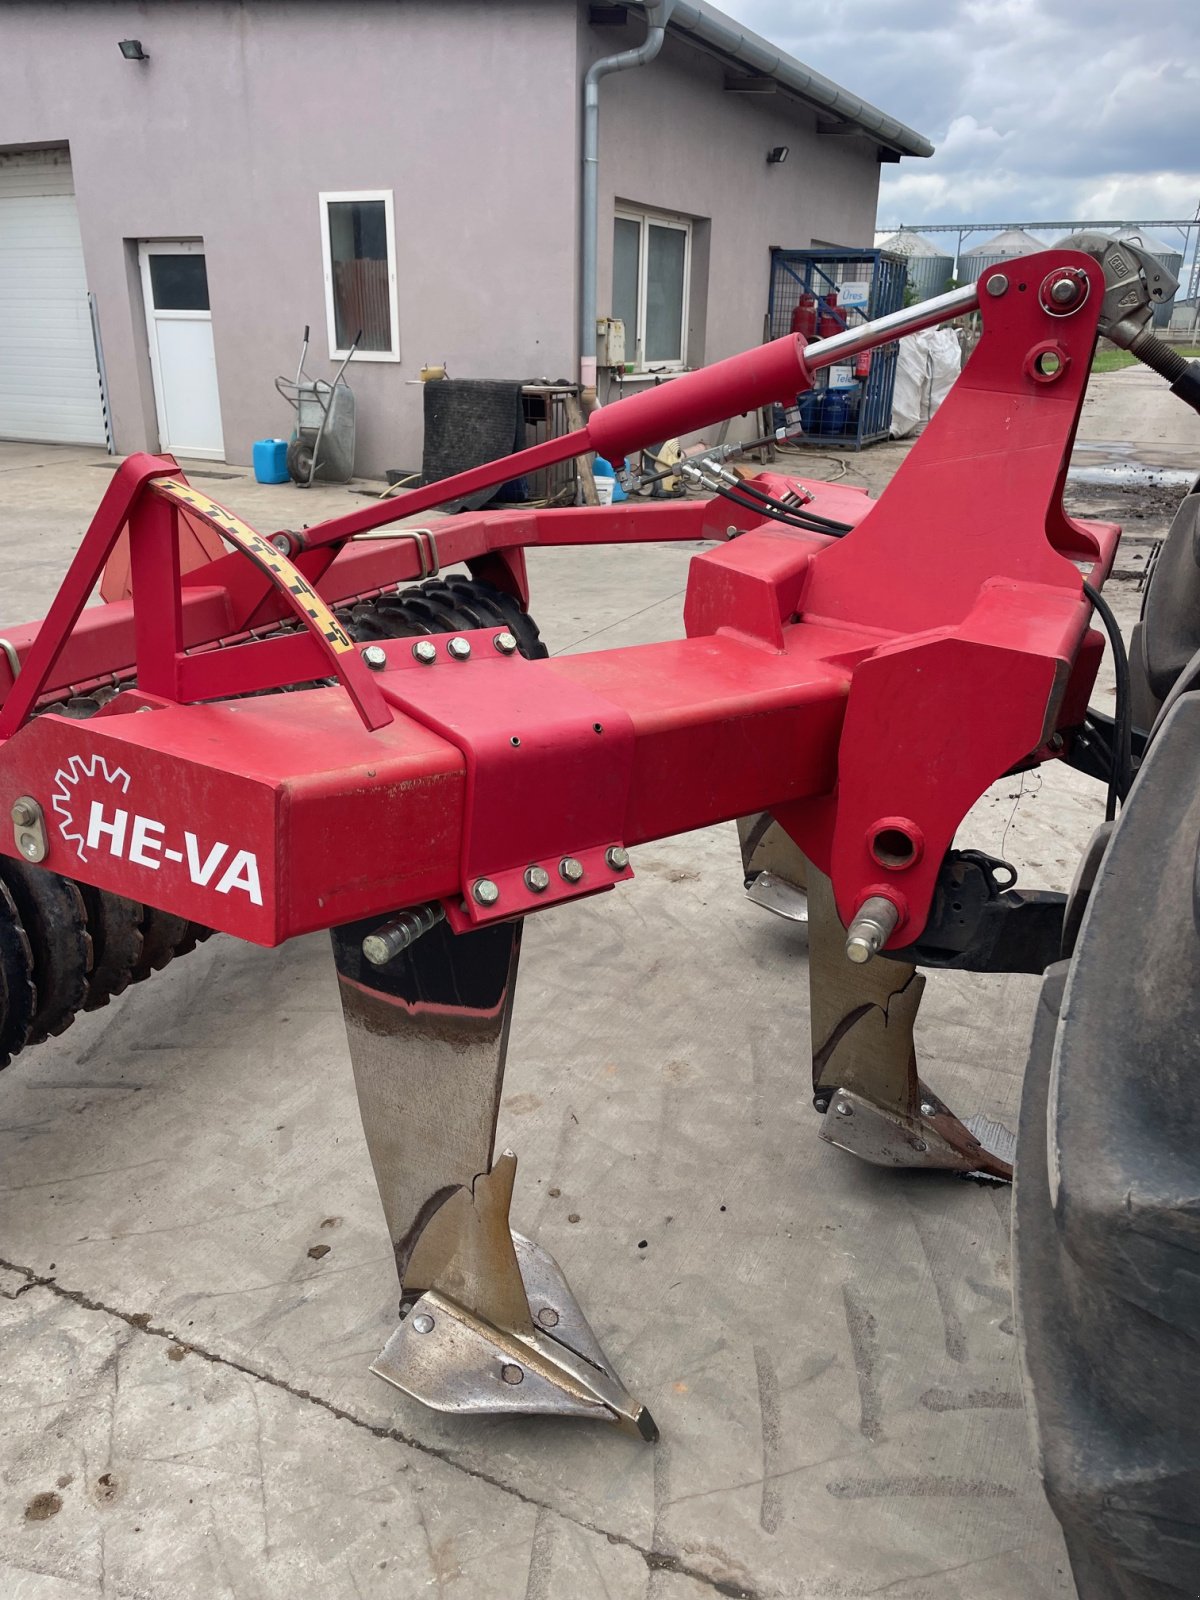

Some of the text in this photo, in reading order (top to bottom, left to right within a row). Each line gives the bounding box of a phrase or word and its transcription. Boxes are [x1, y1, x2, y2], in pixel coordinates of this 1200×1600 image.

[842, 289, 863, 300] Üres
[168, 480, 350, 646] 1 2 3 4 5
[86, 800, 263, 906] HE-VA
